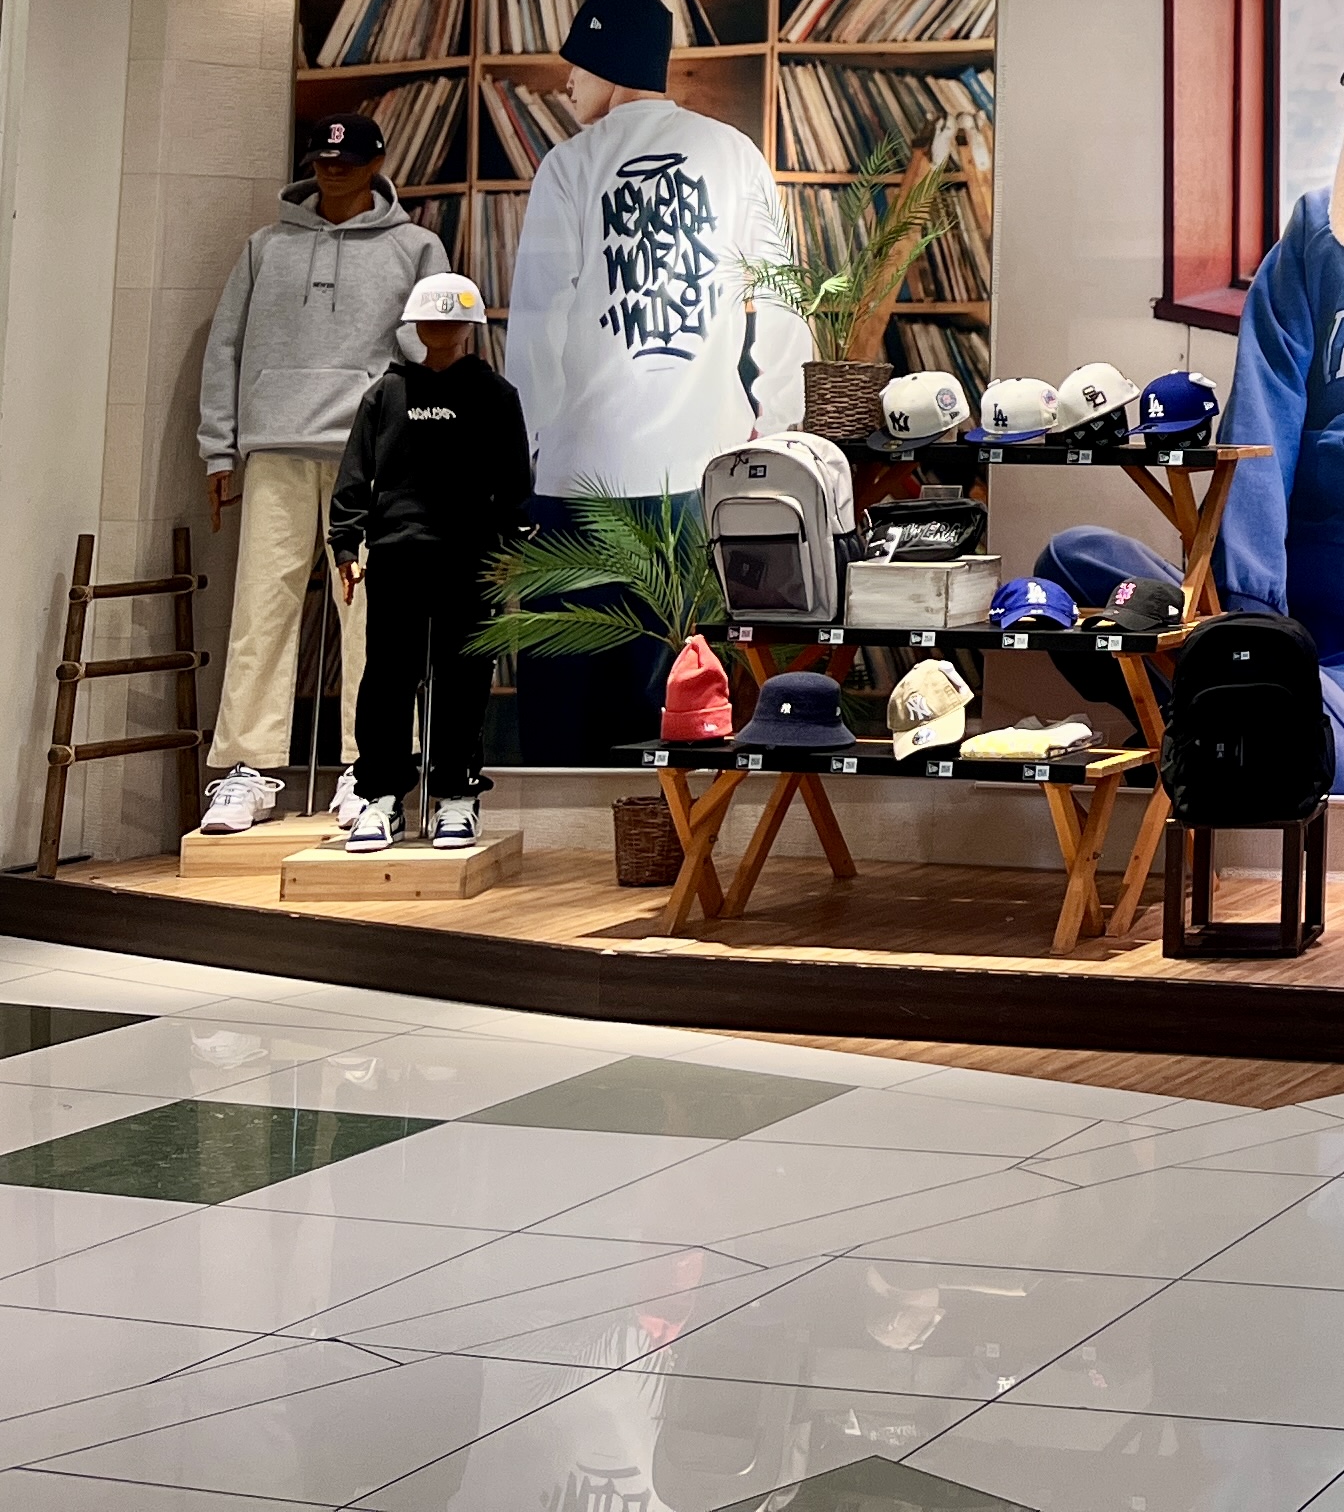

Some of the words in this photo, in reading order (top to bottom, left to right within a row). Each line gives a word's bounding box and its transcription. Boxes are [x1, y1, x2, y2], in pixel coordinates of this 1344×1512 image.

[328, 123, 345, 143] B
[993, 403, 1008, 427] LA
[1148, 393, 1164, 418] LA
[889, 411, 910, 432] NY
